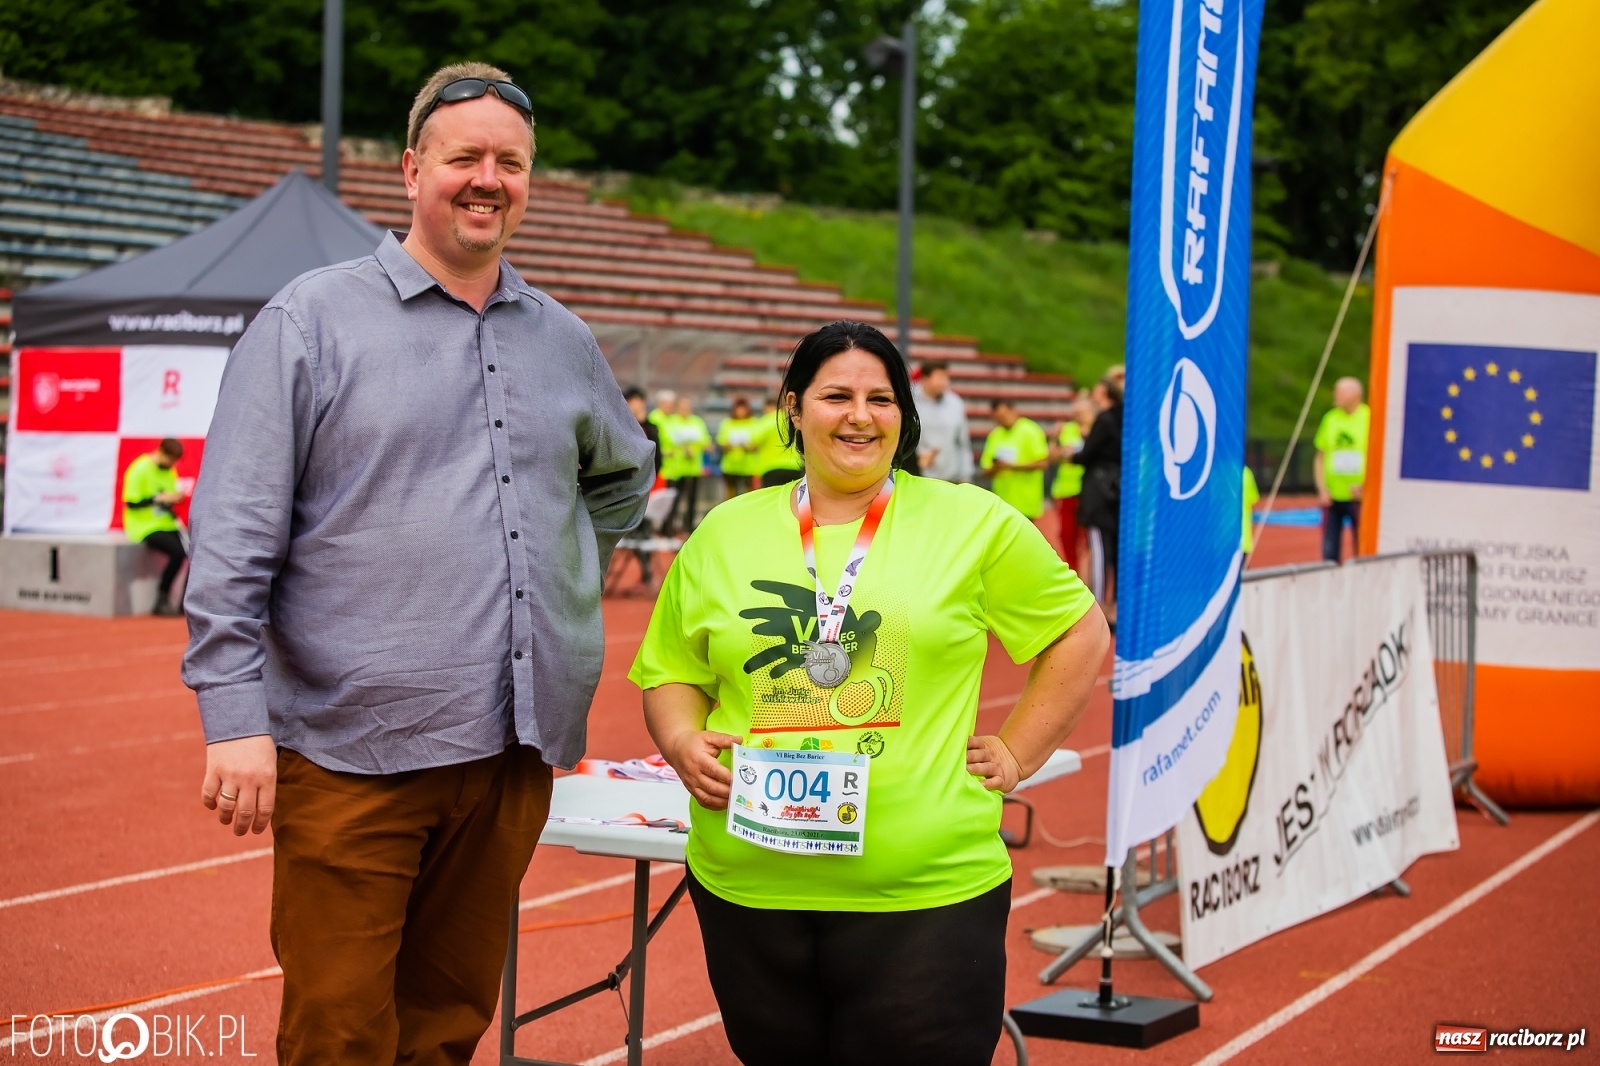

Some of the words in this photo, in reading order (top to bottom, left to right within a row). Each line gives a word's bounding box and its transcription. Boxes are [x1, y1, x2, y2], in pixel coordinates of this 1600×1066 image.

[1182, 0, 1224, 285] RAFAM
[162, 369, 181, 396] R
[1499, 566, 1587, 585] FUNDUSZ
[1516, 608, 1599, 627] GRANICE
[764, 768, 831, 804] 004
[842, 771, 859, 789] R
[1190, 853, 1261, 922] RACIBÓRZ
